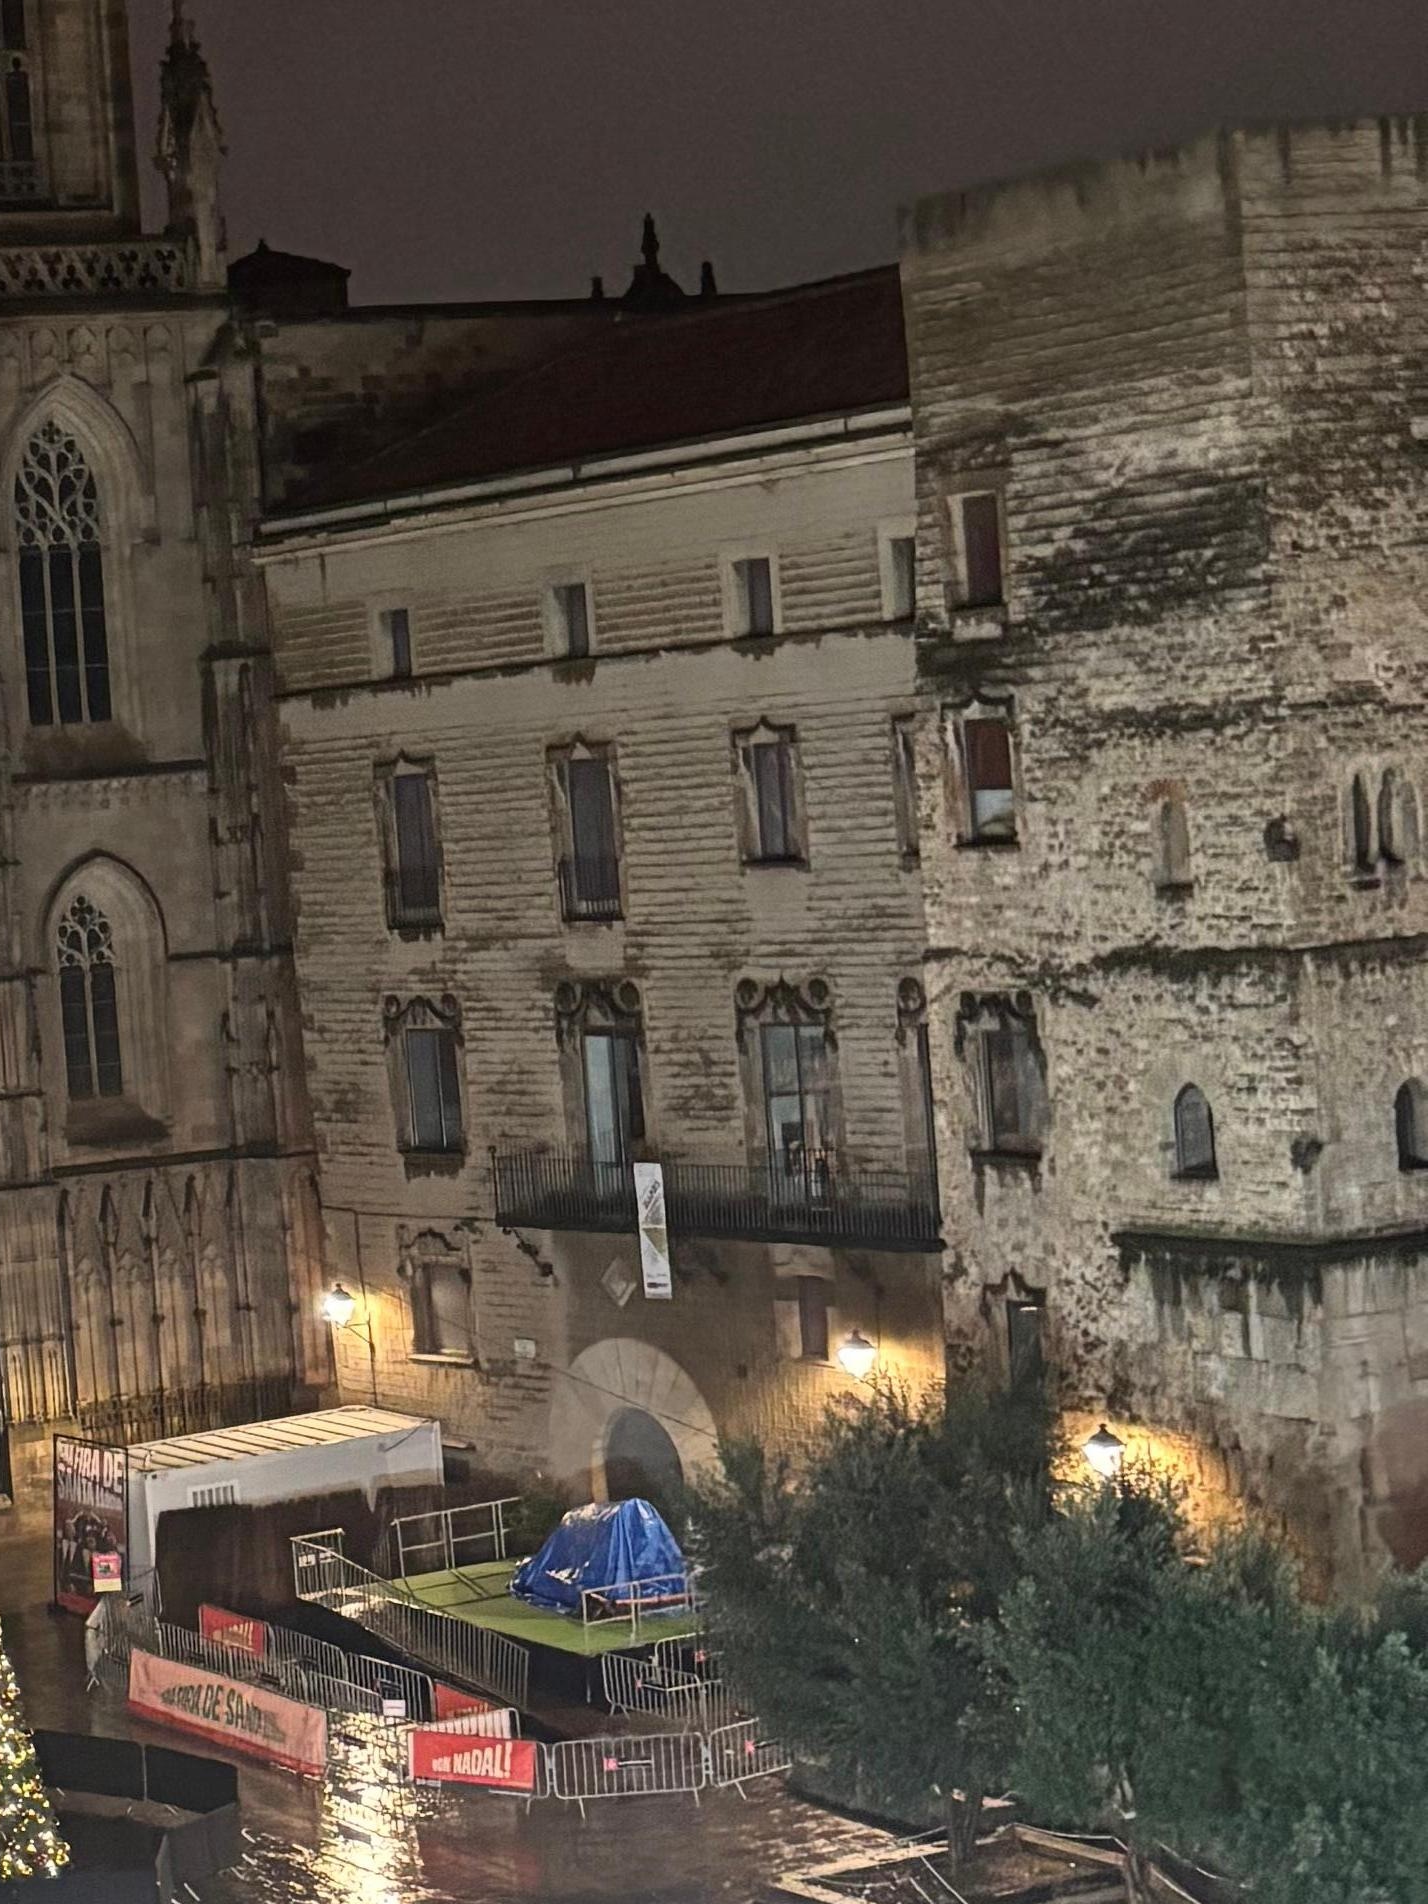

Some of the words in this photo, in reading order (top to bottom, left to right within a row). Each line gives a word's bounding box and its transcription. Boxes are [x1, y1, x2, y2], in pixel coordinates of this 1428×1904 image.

[103, 1450, 126, 1494] DE
[203, 1684, 225, 1722] DE
[453, 1741, 512, 1778] NADAL!
